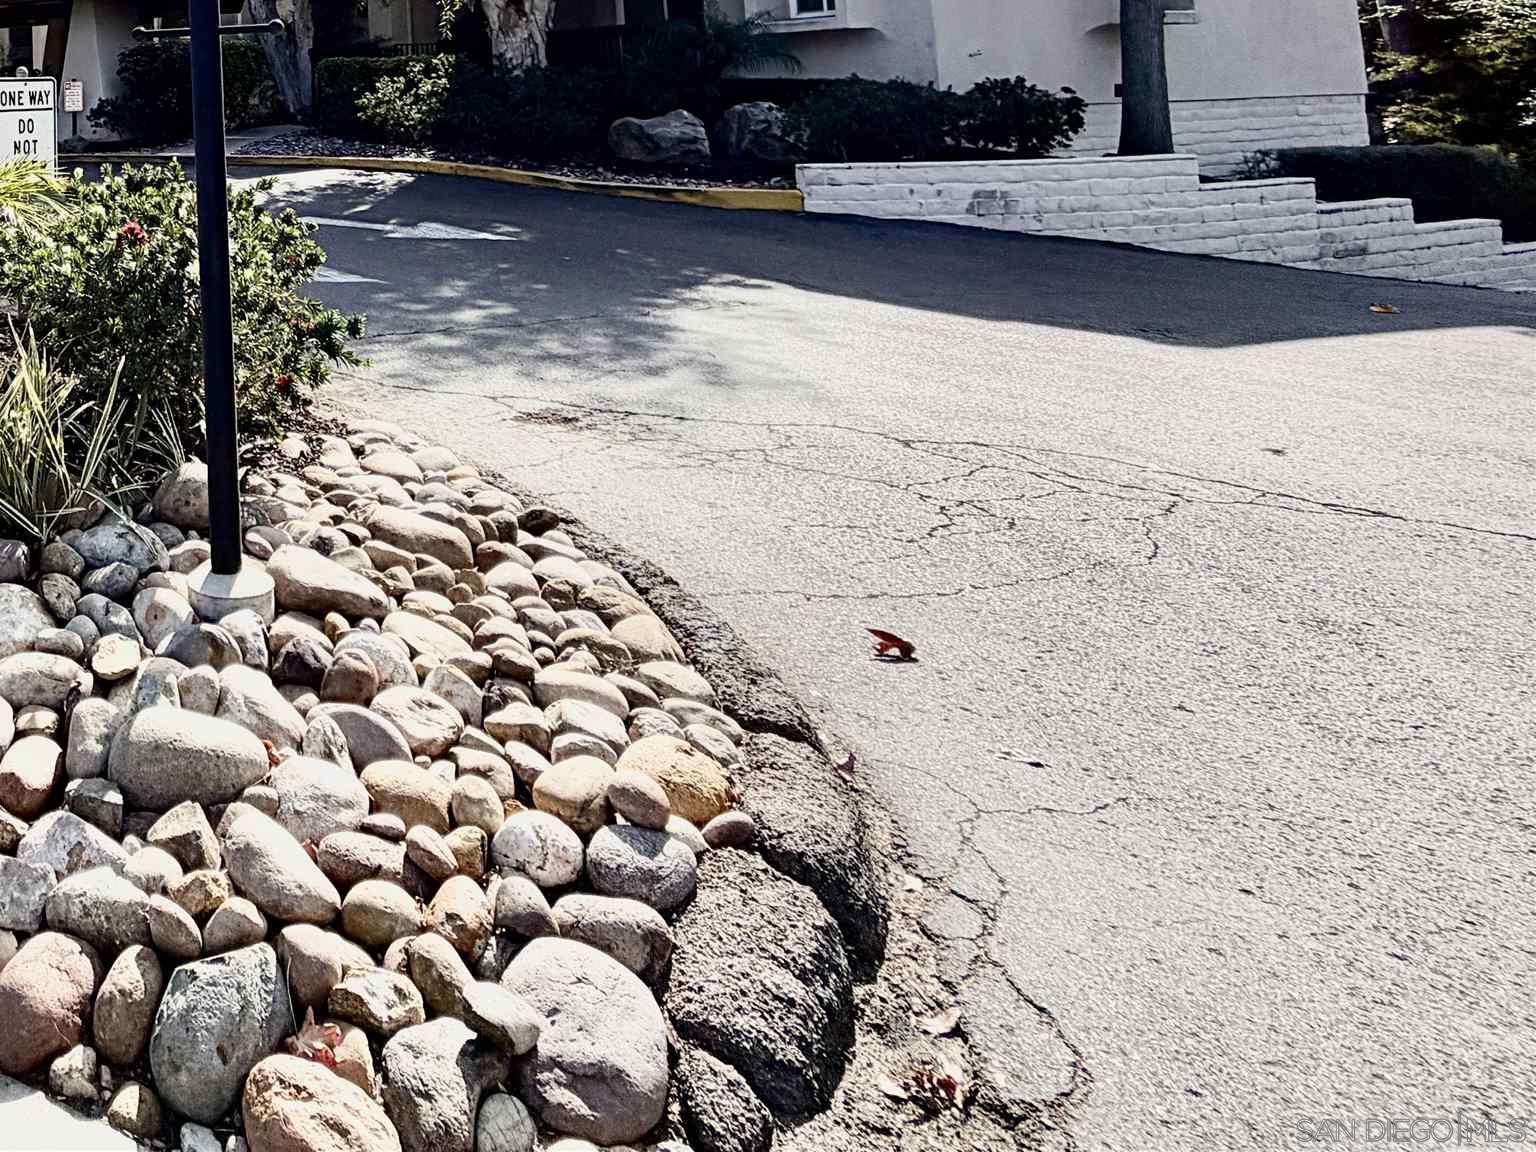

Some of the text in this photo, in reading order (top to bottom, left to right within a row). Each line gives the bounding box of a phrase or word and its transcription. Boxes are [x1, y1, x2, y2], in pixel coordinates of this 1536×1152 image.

[0, 90, 24, 106] ONE
[28, 89, 51, 106] WAY
[18, 118, 34, 134] DO
[13, 139, 38, 155] NOT
